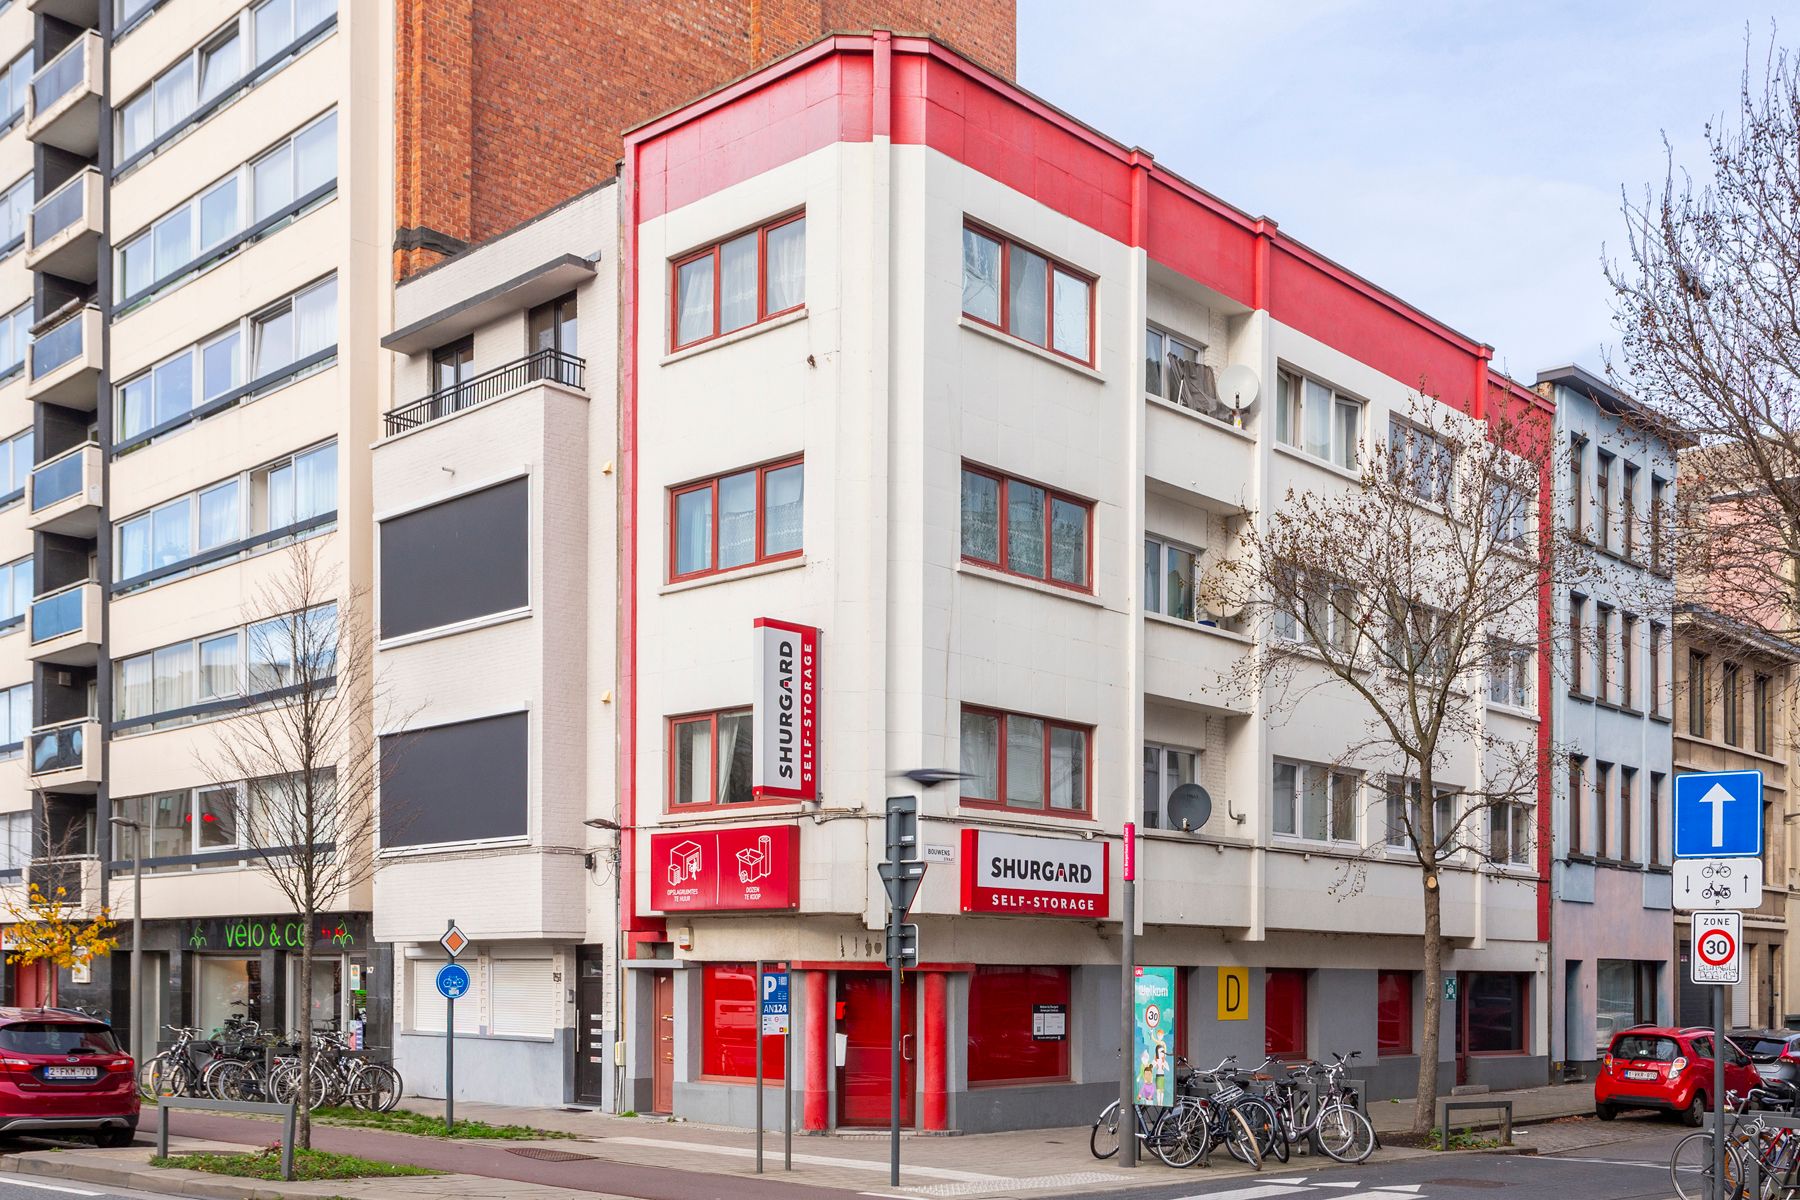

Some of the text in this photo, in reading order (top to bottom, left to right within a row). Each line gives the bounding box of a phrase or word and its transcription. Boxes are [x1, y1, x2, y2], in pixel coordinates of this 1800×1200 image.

[779, 640, 793, 779] SHURGARD
[803, 643, 812, 782] SELF-STORAGE
[927, 848, 951, 857] BOUWENS
[990, 856, 1092, 884] SHURGARD
[992, 894, 1095, 911] SELF-STORAGE
[1703, 917, 1730, 926] ZONE
[224, 919, 265, 947] vélo
[269, 922, 281, 947] &
[1706, 939, 1728, 955] 30
[763, 976, 777, 1001] P
[1226, 974, 1240, 1012] D
[763, 1004, 788, 1013] AN124
[1148, 1010, 1158, 1021] 30
